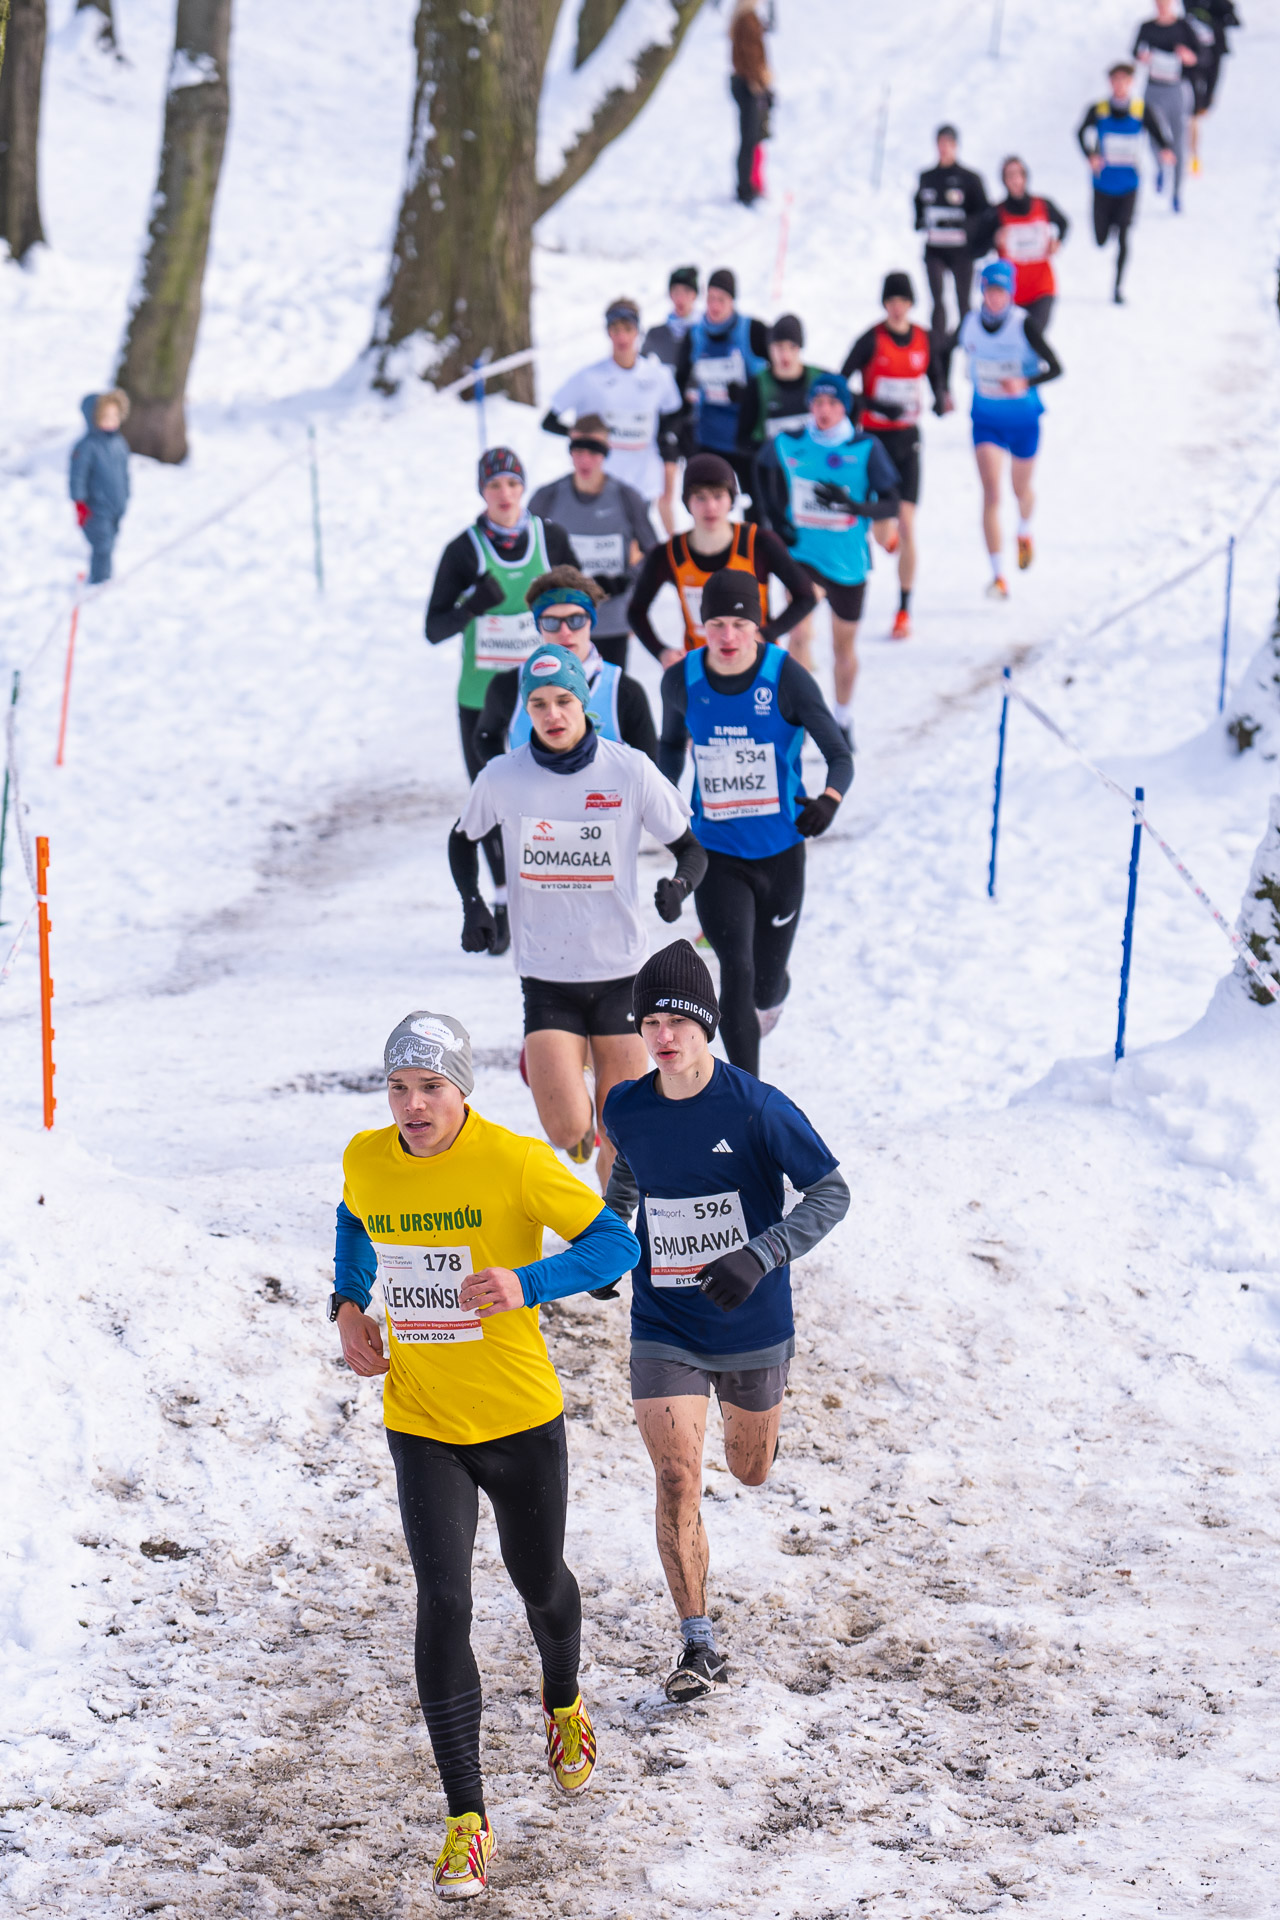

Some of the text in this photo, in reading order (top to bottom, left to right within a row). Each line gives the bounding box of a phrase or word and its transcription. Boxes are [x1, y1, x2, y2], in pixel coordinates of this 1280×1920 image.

[735, 750, 766, 764] 534
[580, 826, 602, 840] 30
[523, 850, 612, 866] DOMAGAŁA
[693, 1198, 732, 1219] 596
[367, 1207, 482, 1233] AKL URSYNÓW
[653, 1227, 744, 1256] SMURAWA
[423, 1253, 462, 1271] 178
[675, 1276, 702, 1285] BYTO
[431, 1332, 455, 1340] 2024
